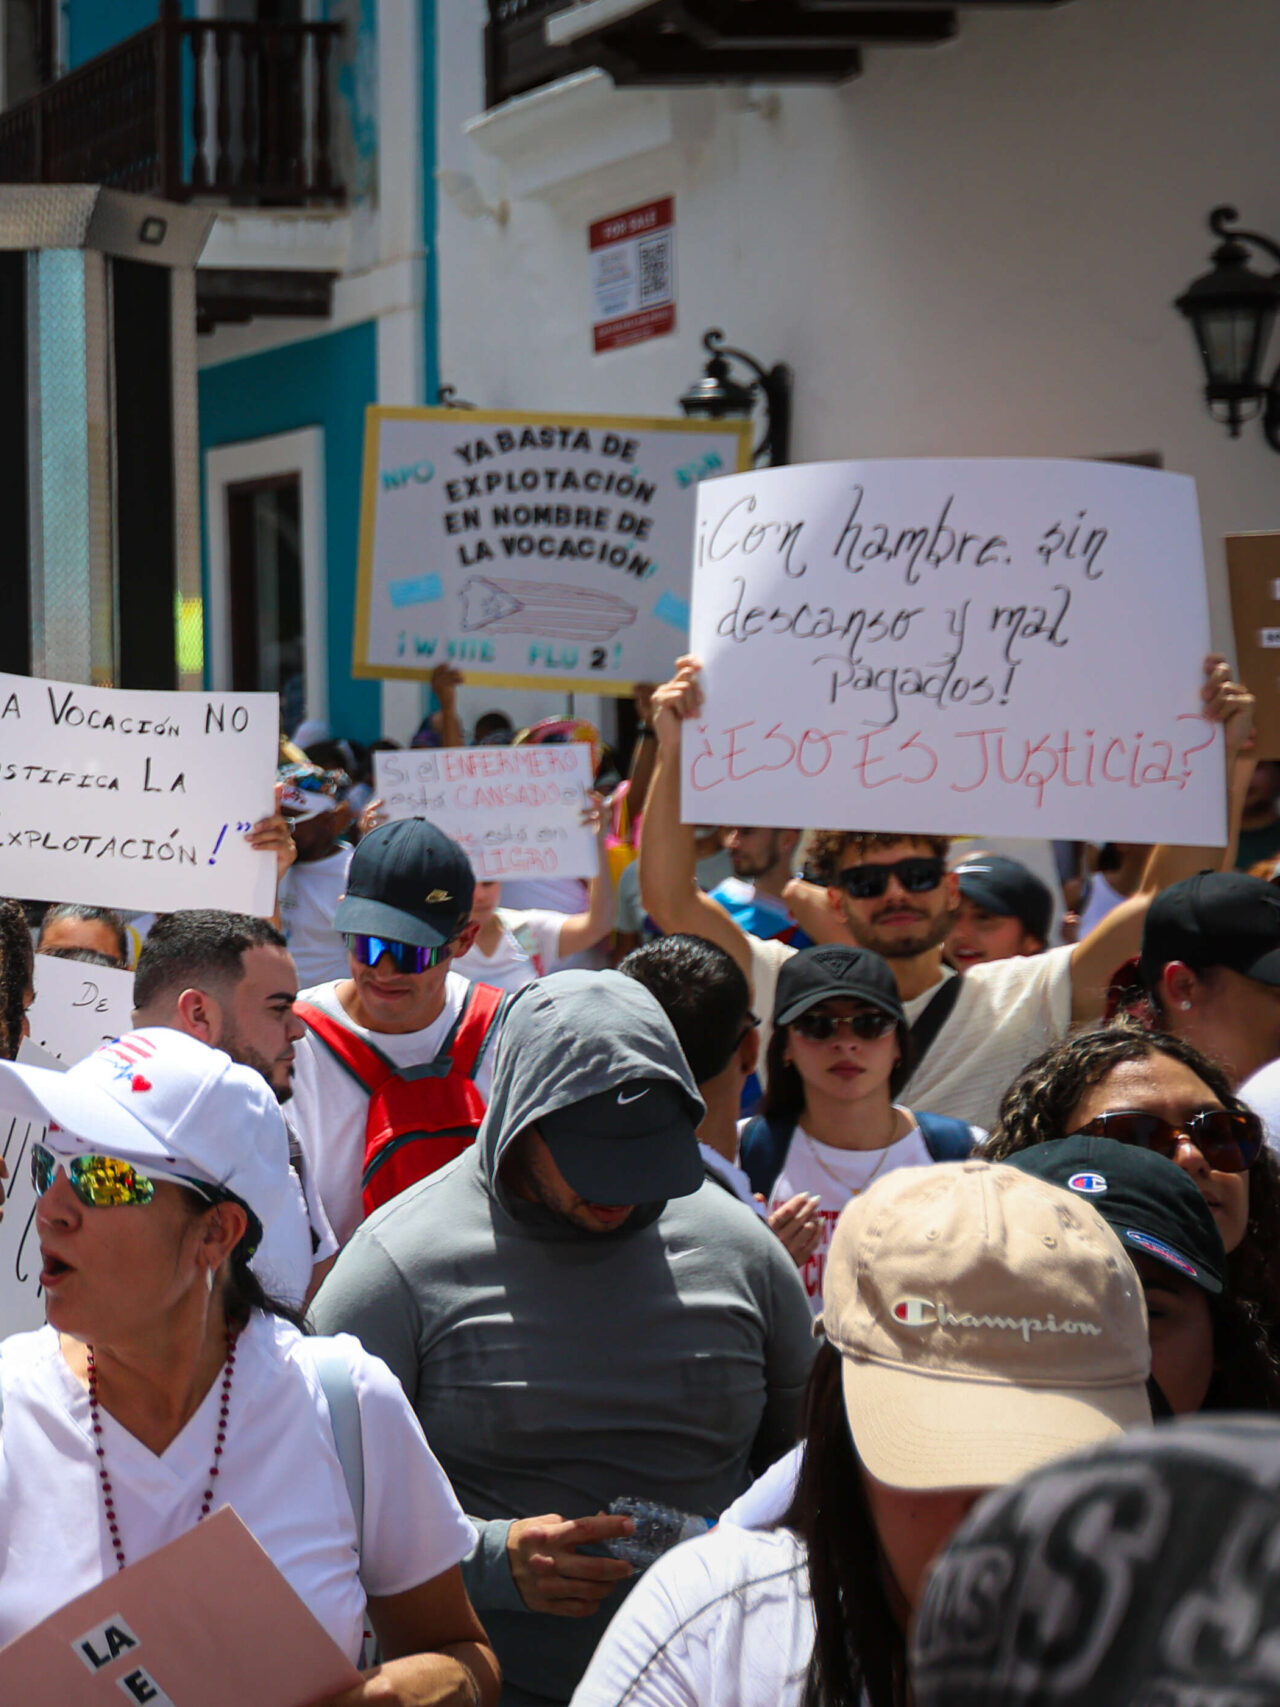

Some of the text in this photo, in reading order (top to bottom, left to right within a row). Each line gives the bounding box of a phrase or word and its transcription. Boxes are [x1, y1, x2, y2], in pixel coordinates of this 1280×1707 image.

[455, 425, 641, 467] YA BASTA DE
[444, 504, 655, 543] EN NOMBRE DE
[699, 493, 807, 578] ¡Con
[1036, 508, 1109, 581] sin
[458, 538, 494, 568] LA
[716, 576, 1071, 667] descanso y mal
[203, 702, 249, 735] NO
[143, 756, 187, 795] LA
[441, 748, 579, 783] ENFERMERO
[690, 720, 849, 792] ¿ESO
[852, 727, 939, 790] ES
[453, 782, 561, 809] CANSADO
[467, 847, 559, 877] LIGRO
[890, 1297, 1102, 1343] Champion
[81, 1625, 136, 1669] LA
